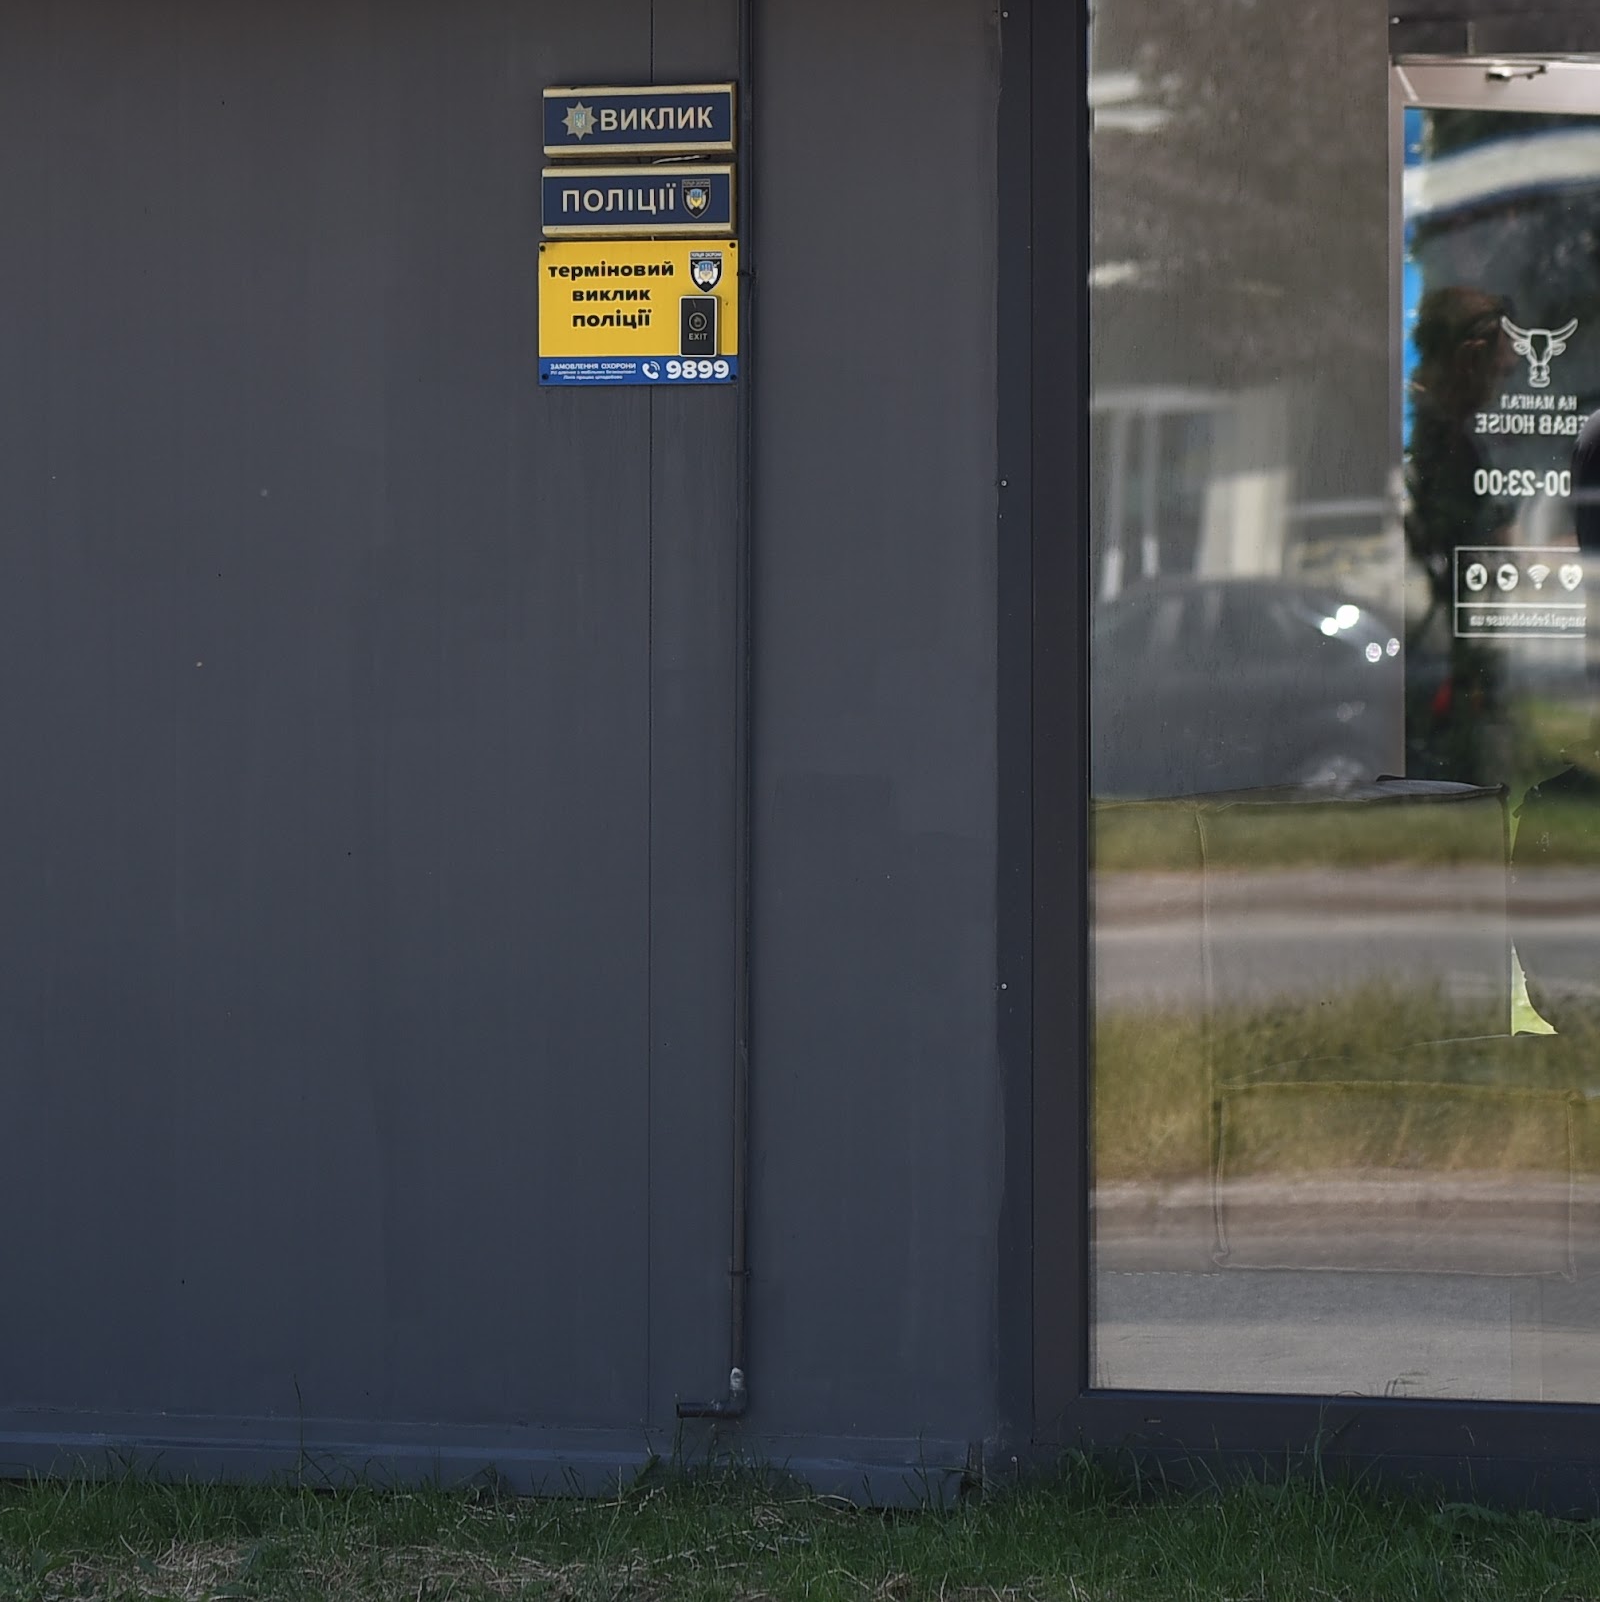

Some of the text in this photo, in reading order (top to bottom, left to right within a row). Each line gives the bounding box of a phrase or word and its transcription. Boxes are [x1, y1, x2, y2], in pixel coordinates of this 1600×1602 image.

[599, 106, 714, 132] ВИКЛИК
[561, 182, 677, 215] ПОЛІЦІЇ
[548, 260, 674, 280] терміновий
[572, 288, 651, 302] виклик
[572, 308, 652, 328] поліції
[688, 332, 708, 341] EXIT
[665, 360, 730, 380] 9899
